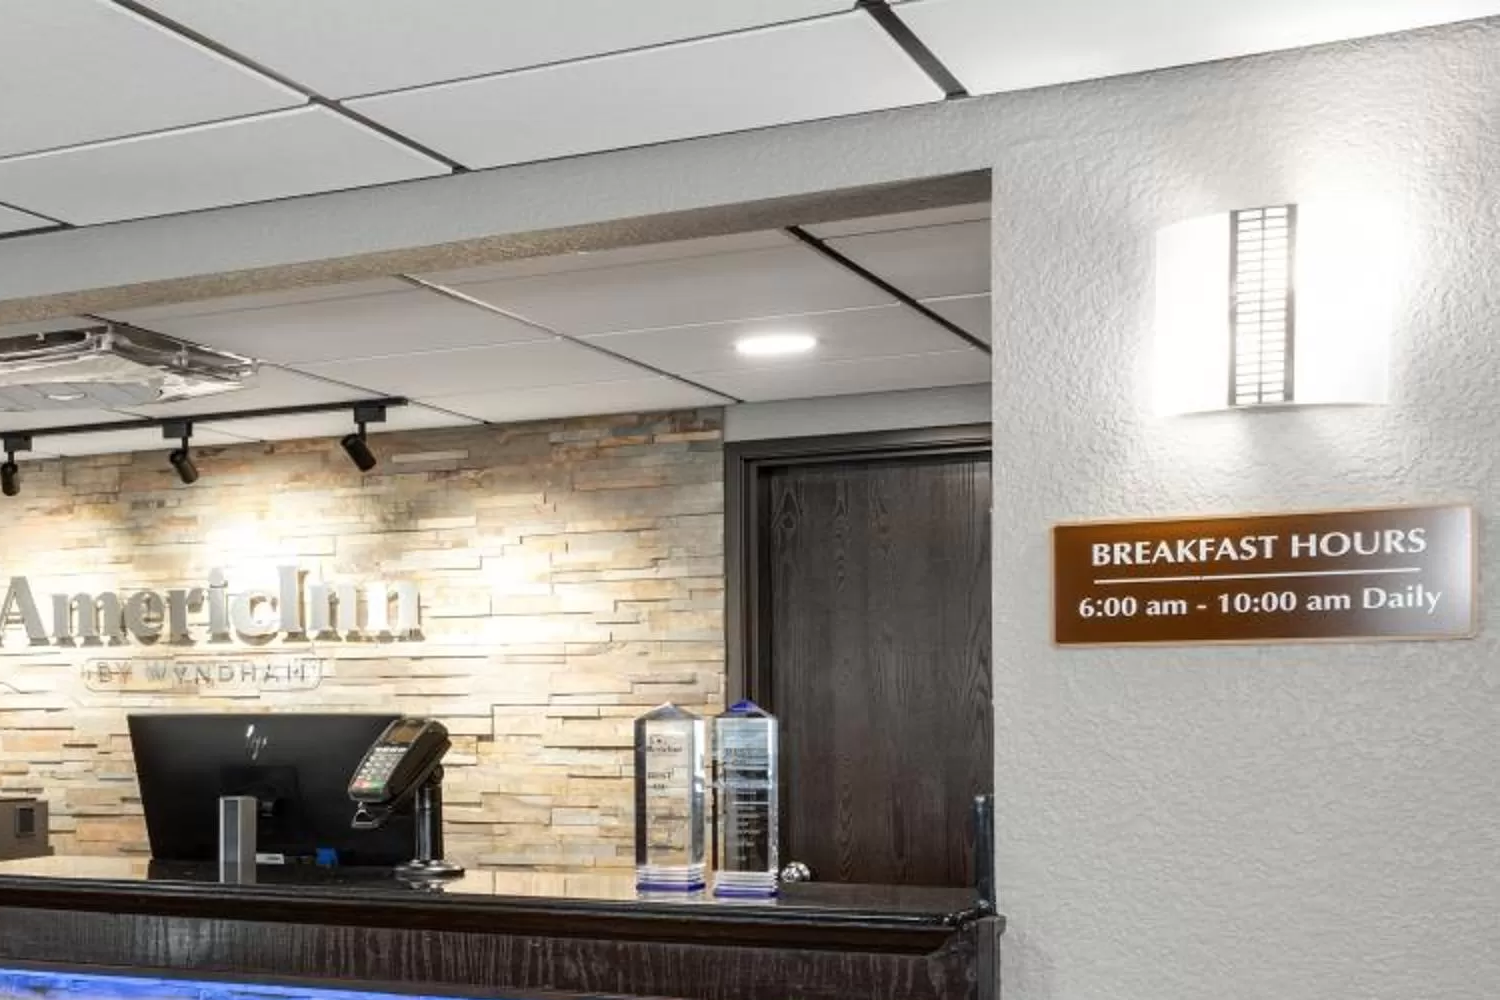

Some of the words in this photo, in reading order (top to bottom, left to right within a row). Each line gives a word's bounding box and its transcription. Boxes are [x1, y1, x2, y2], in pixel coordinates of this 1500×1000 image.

[1090, 534, 1279, 568] BREAKFAST
[1290, 527, 1428, 560] HOURS
[1078, 596, 1137, 618] 6:00
[1146, 597, 1188, 617] am
[1217, 591, 1297, 614] 10:00
[1305, 592, 1352, 612] am
[1362, 584, 1444, 615] Daily
[98, 662, 133, 684] BY
